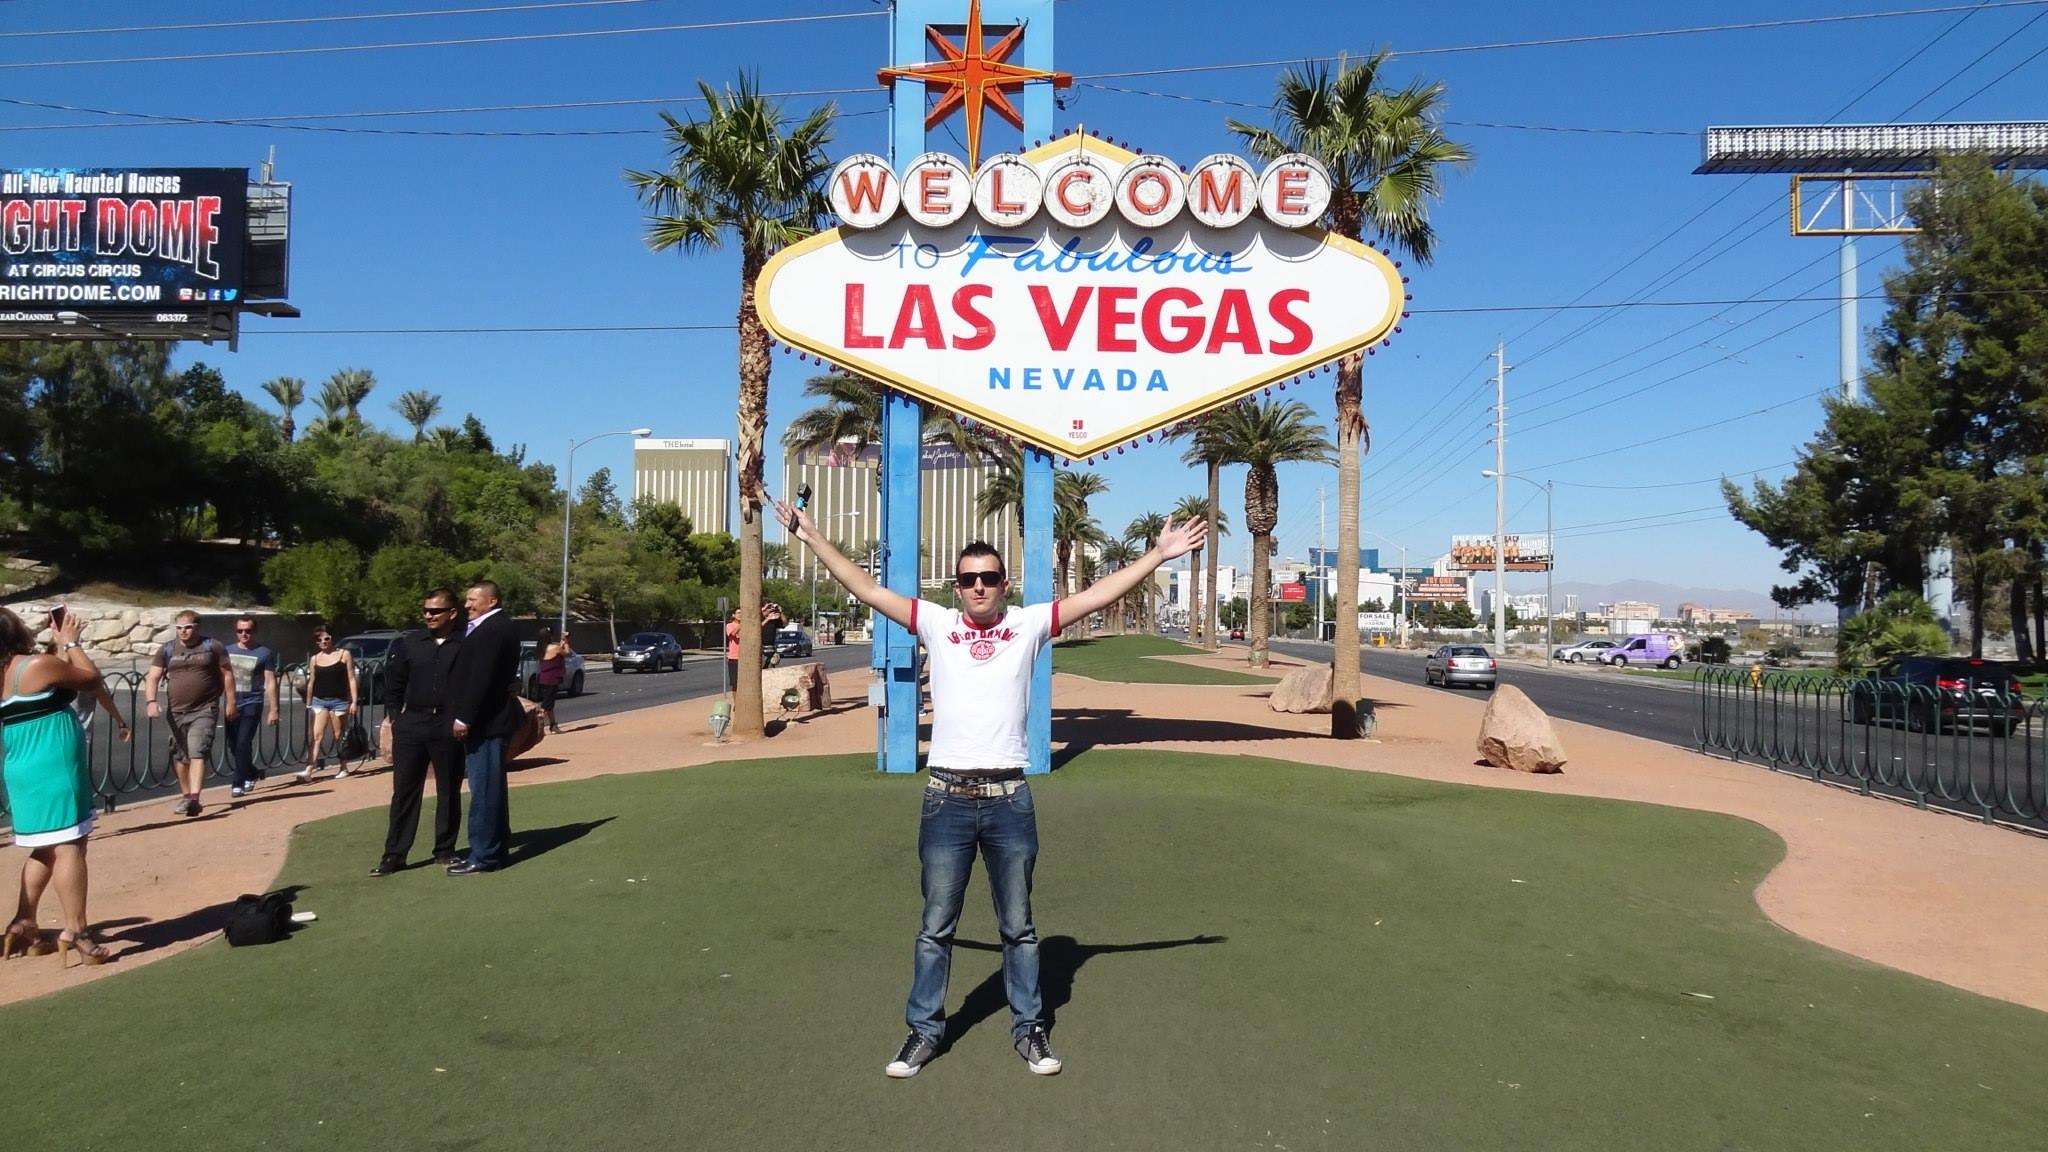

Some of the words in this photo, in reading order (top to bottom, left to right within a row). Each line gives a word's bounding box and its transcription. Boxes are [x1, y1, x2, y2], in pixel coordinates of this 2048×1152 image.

[3, 173, 59, 193] All-New
[65, 173, 123, 193] Haunted
[128, 173, 181, 193] Houses
[840, 168, 1312, 216] WELCOME
[0, 199, 86, 254] GHT
[96, 196, 221, 280] DOME
[891, 243, 940, 269] TO
[961, 234, 1253, 277] Fabulous
[8, 264, 30, 277] AT
[33, 264, 85, 277] CIRCUS
[88, 264, 141, 277] CIRCUS
[0, 285, 160, 300] RIGHTDOME.COM
[844, 283, 996, 351] LAS
[1027, 285, 1312, 356] VEGAS
[988, 367, 1169, 392] NEVADA
[1068, 431, 1087, 439] YESCO
